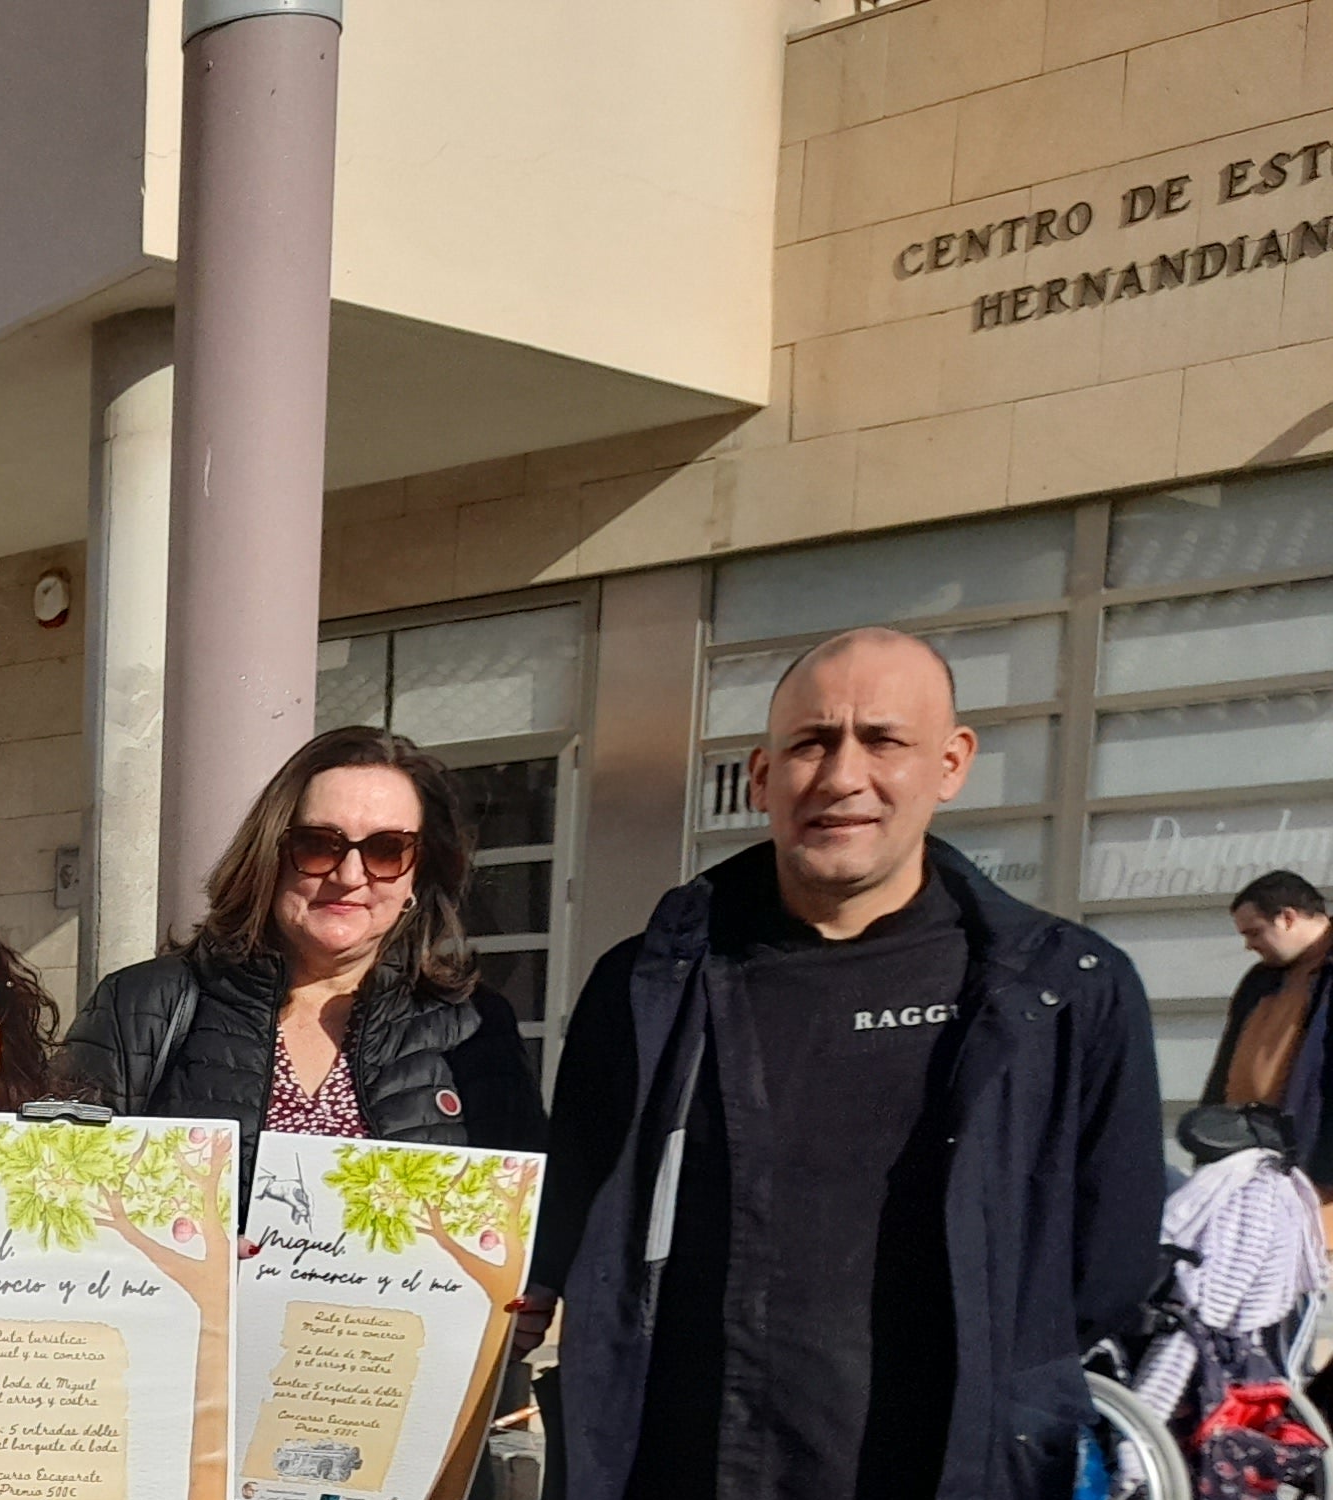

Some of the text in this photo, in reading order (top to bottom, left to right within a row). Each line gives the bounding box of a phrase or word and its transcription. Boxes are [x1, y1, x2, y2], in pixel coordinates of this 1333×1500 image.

[893, 201, 1094, 281] CENTRO
[1120, 174, 1193, 229] DE
[58, 1280, 77, 1305] y
[87, 1270, 111, 1299] el
[255, 1264, 282, 1280] su
[290, 1268, 368, 1285] comercio
[377, 1276, 393, 1295] y
[401, 1269, 423, 1293] el
[22, 1351, 29, 1362] y
[33, 1350, 49, 1359] su
[53, 1351, 106, 1361] comercio
[2, 1375, 32, 1389] boda
[36, 1376, 52, 1390] de
[56, 1376, 97, 1394] Miguel
[6, 1395, 43, 1409] arroz
[47, 1397, 55, 1408] y
[60, 1392, 98, 1406] costra
[9, 1423, 19, 1436] 5
[22, 1422, 79, 1436] entradas
[83, 1423, 118, 1437] dobles
[11, 1437, 66, 1456] banquete
[70, 1439, 86, 1452] de
[88, 1438, 118, 1453] boda
[36, 1468, 102, 1485] Escaparate
